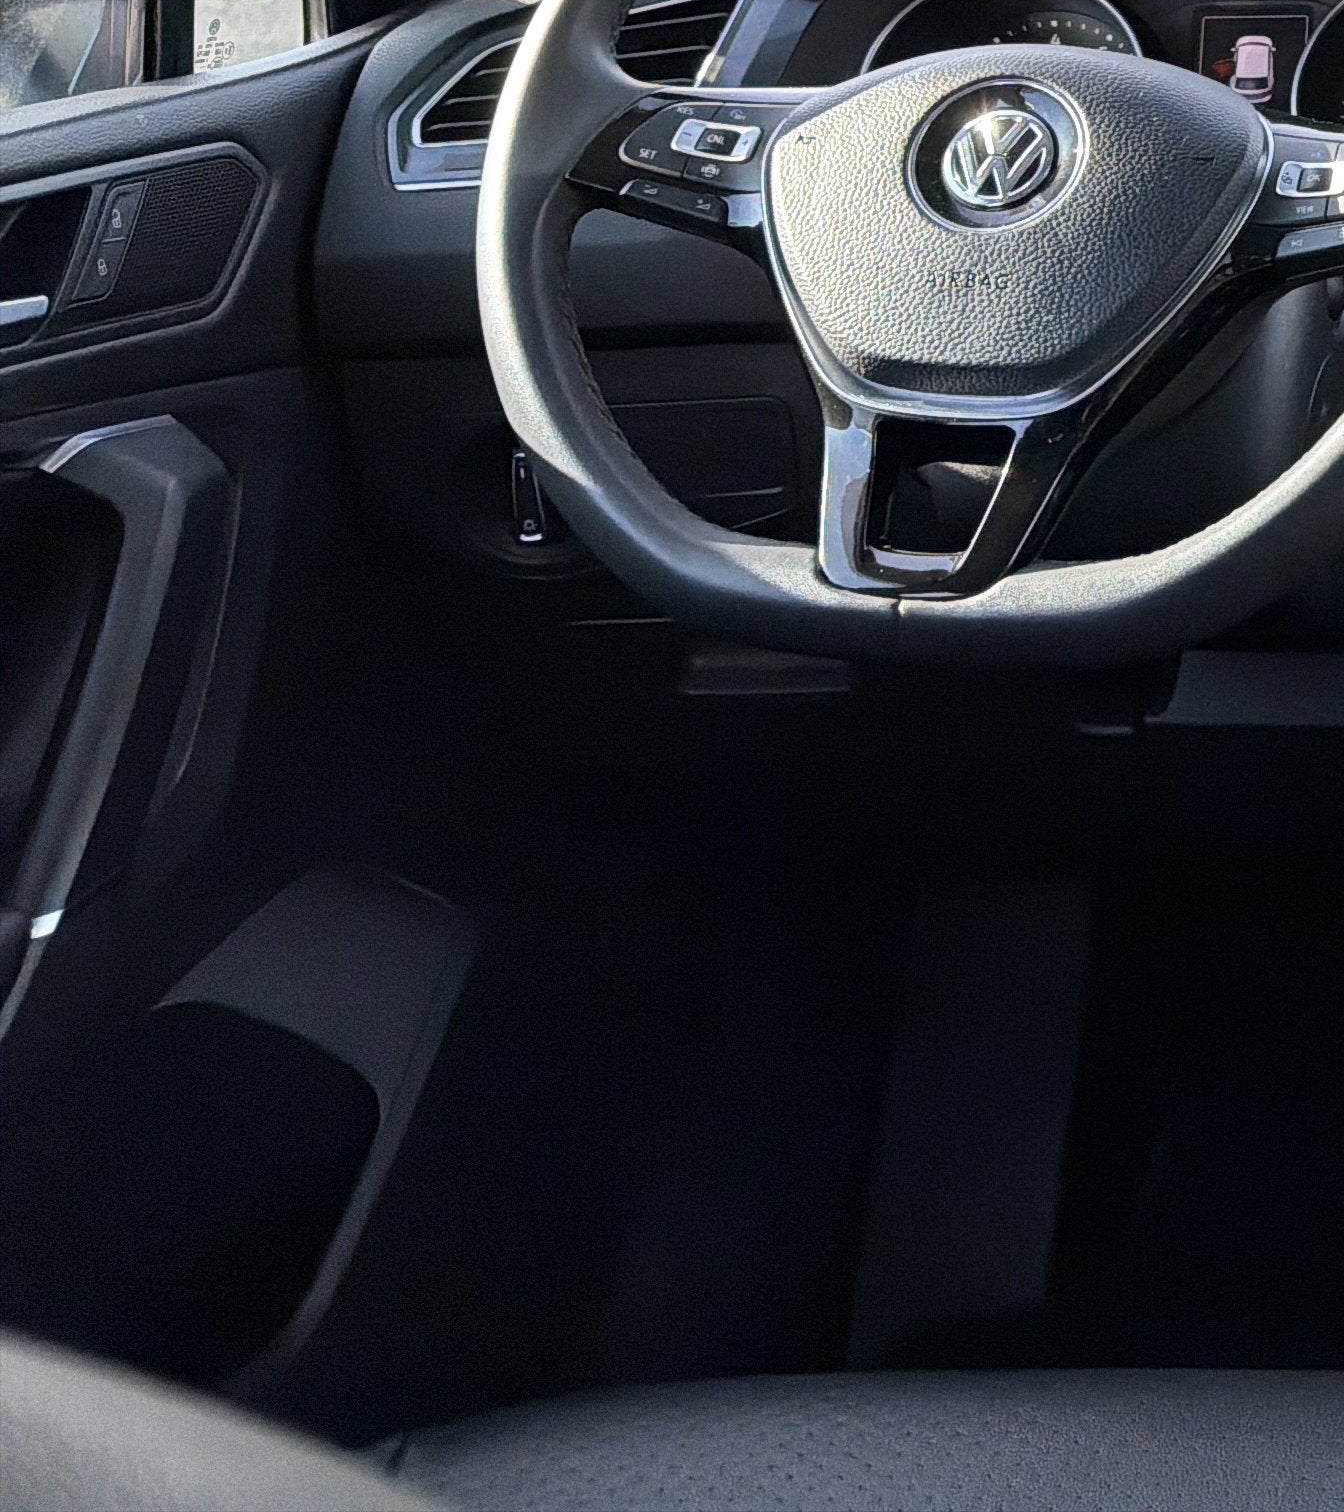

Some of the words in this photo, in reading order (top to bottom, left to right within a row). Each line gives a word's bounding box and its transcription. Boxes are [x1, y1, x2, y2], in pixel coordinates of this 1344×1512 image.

[1050, 33, 1061, 45] 4
[639, 148, 657, 160] SET
[926, 271, 1010, 289] AIRBAG
